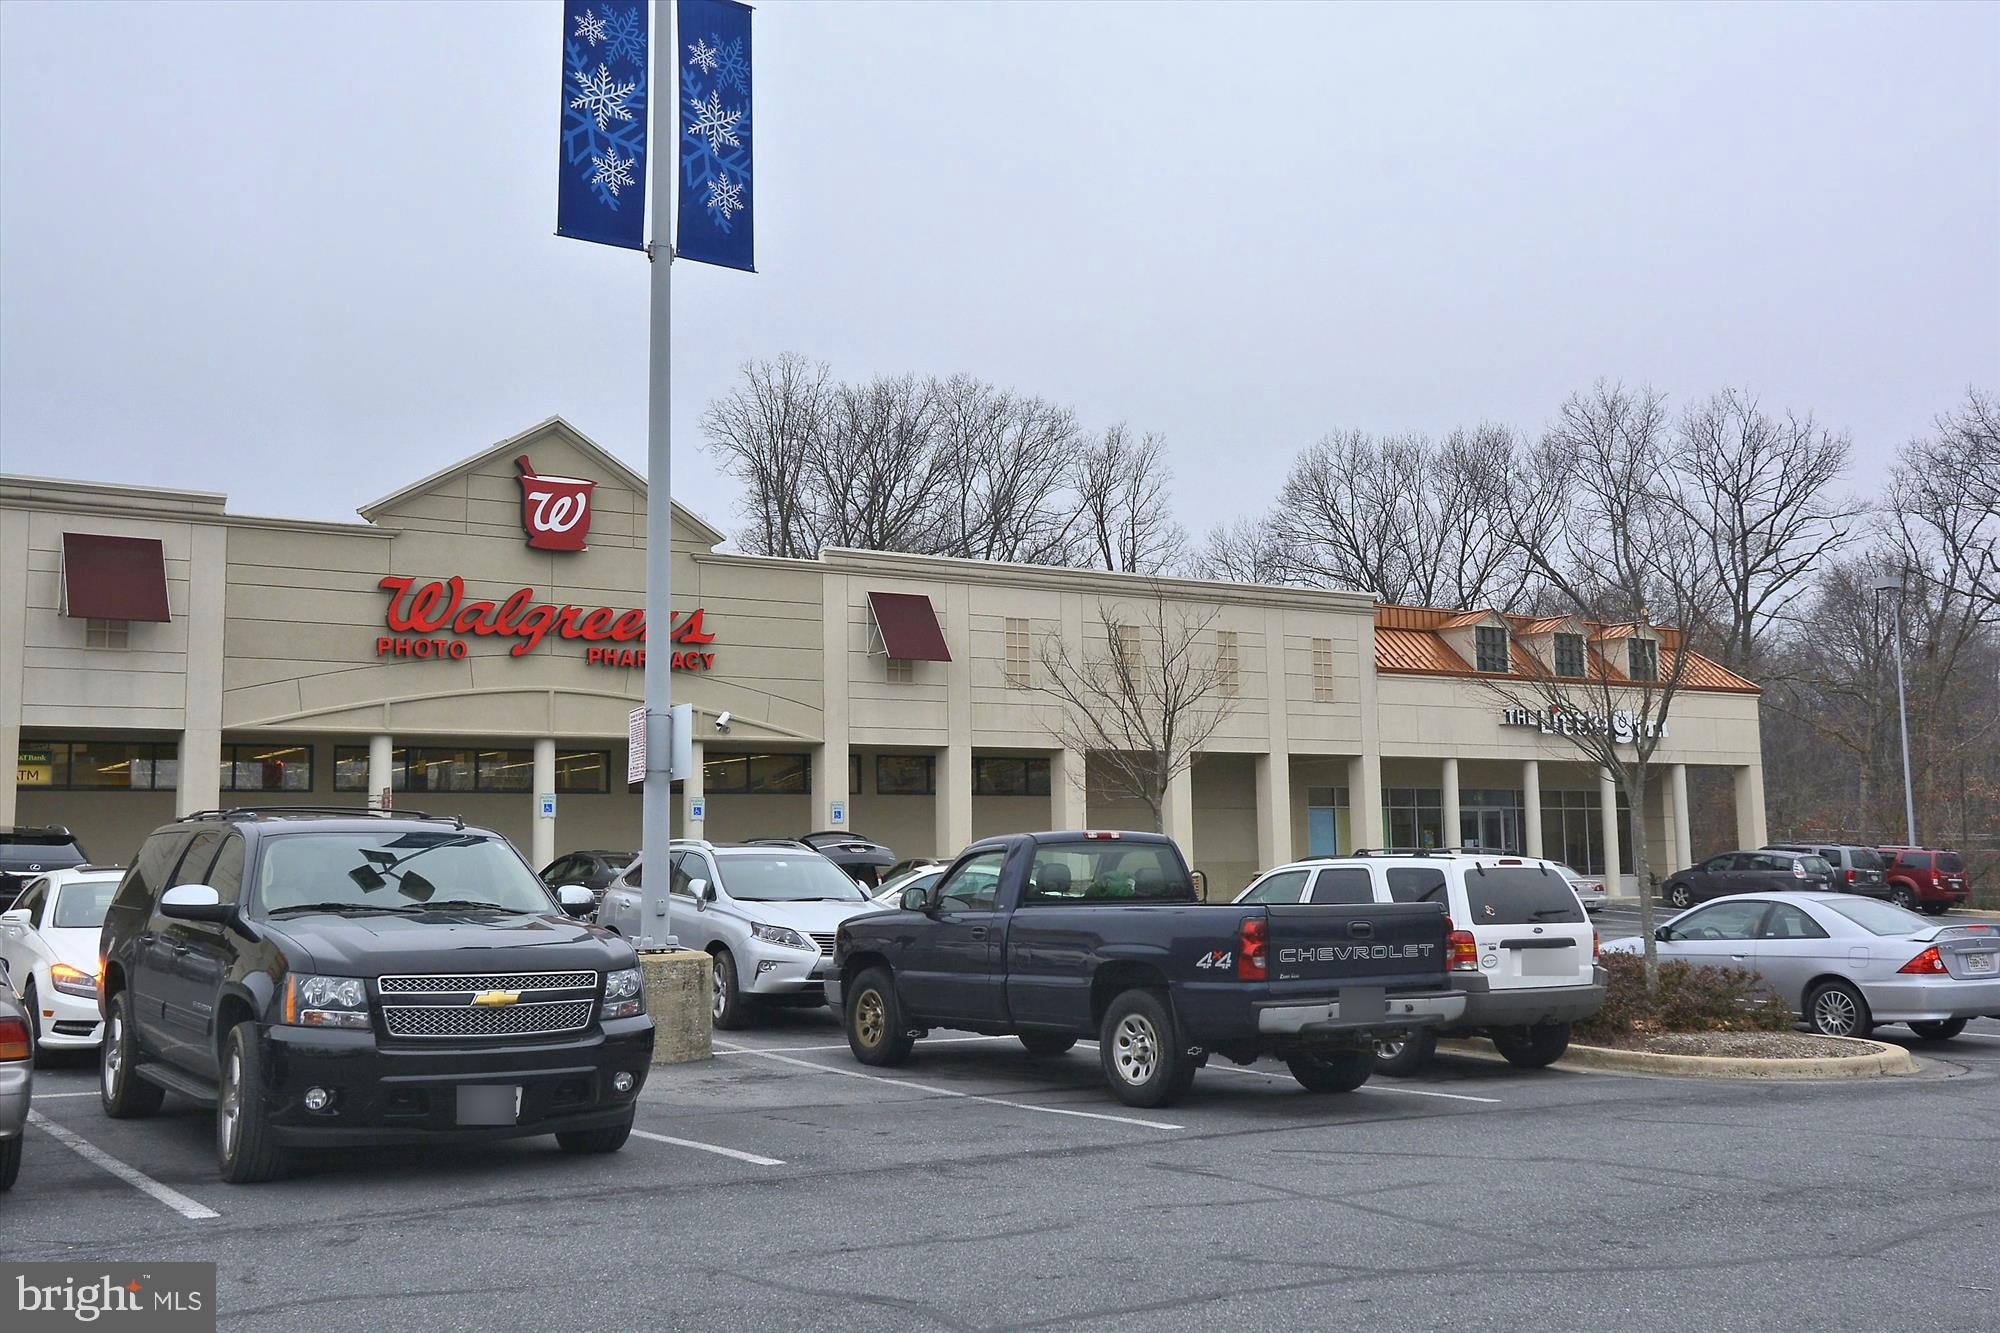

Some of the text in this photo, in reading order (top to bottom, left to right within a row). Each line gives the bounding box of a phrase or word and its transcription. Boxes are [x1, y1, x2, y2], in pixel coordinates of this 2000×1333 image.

[527, 491, 587, 533] W
[378, 575, 716, 657] Walgrees
[376, 637, 468, 660] PHOTO
[586, 647, 716, 671] PHARACY
[16, 769, 39, 781] TM
[1279, 943, 1435, 963] CHEVROLET
